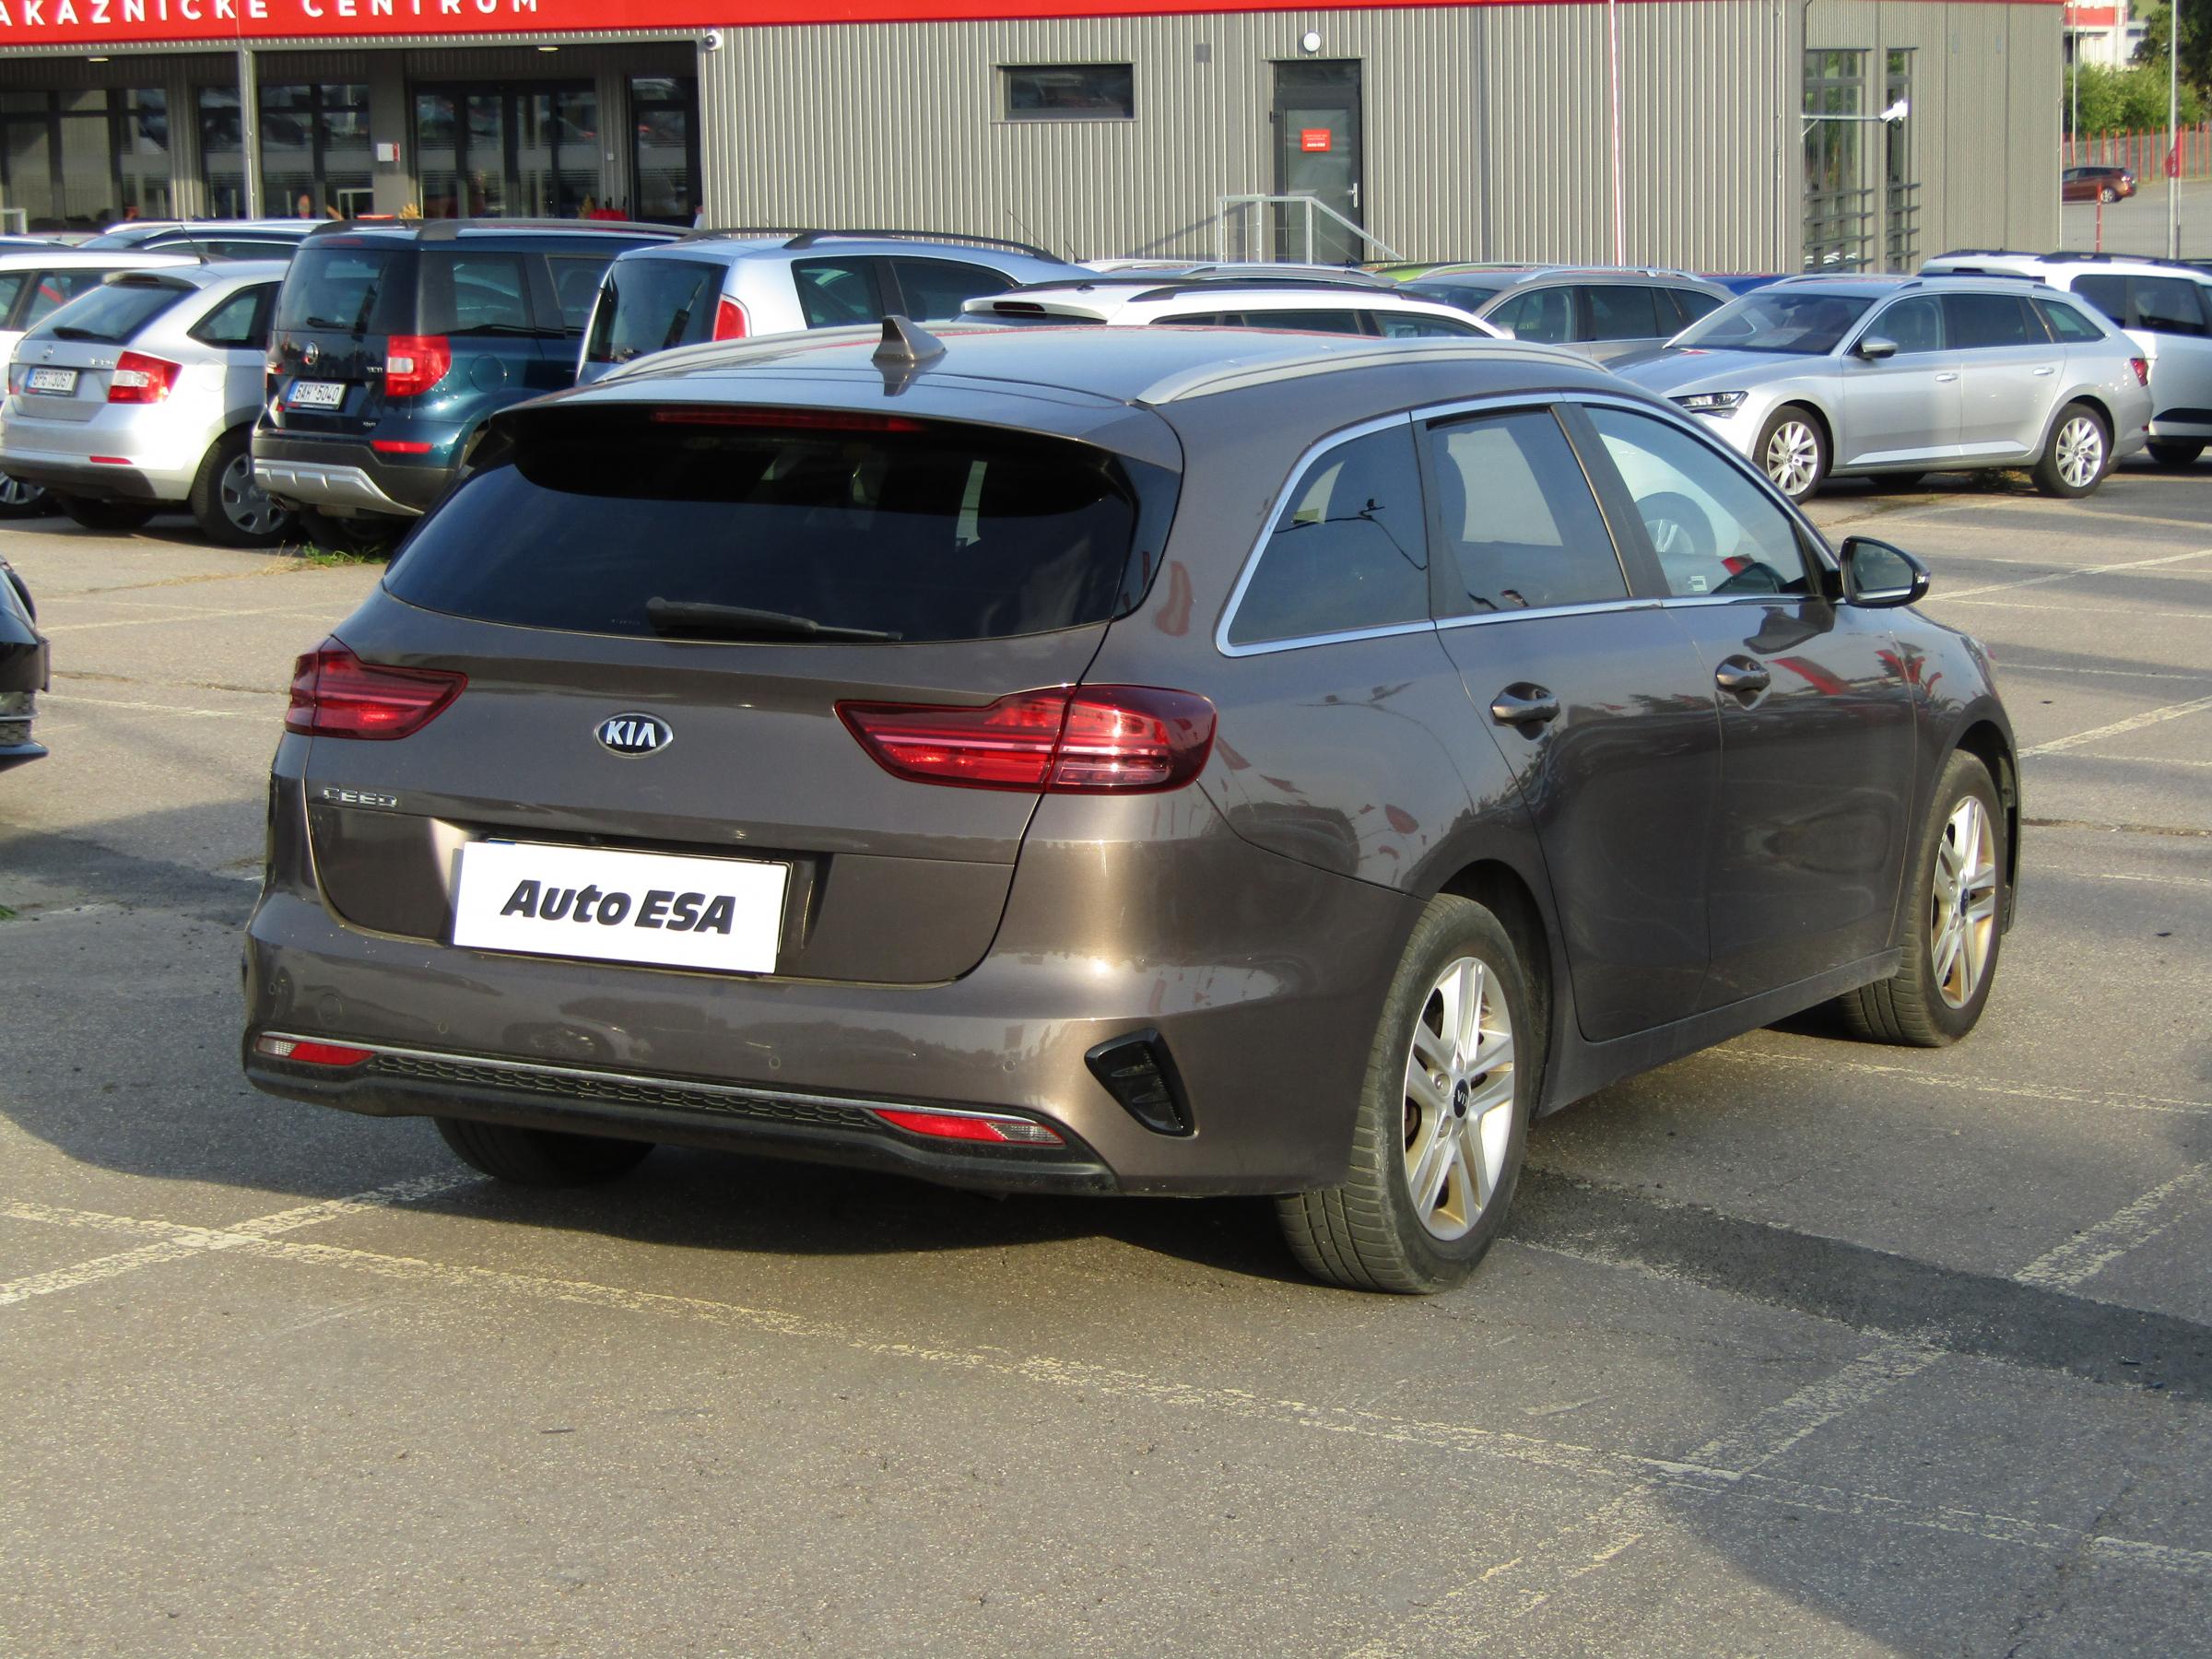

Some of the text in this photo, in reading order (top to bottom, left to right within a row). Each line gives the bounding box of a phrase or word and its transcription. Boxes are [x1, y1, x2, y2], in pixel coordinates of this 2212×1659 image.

[315, 384, 340, 403] 5040
[606, 721, 656, 747] KIA
[500, 879, 736, 935] Auto ESA
